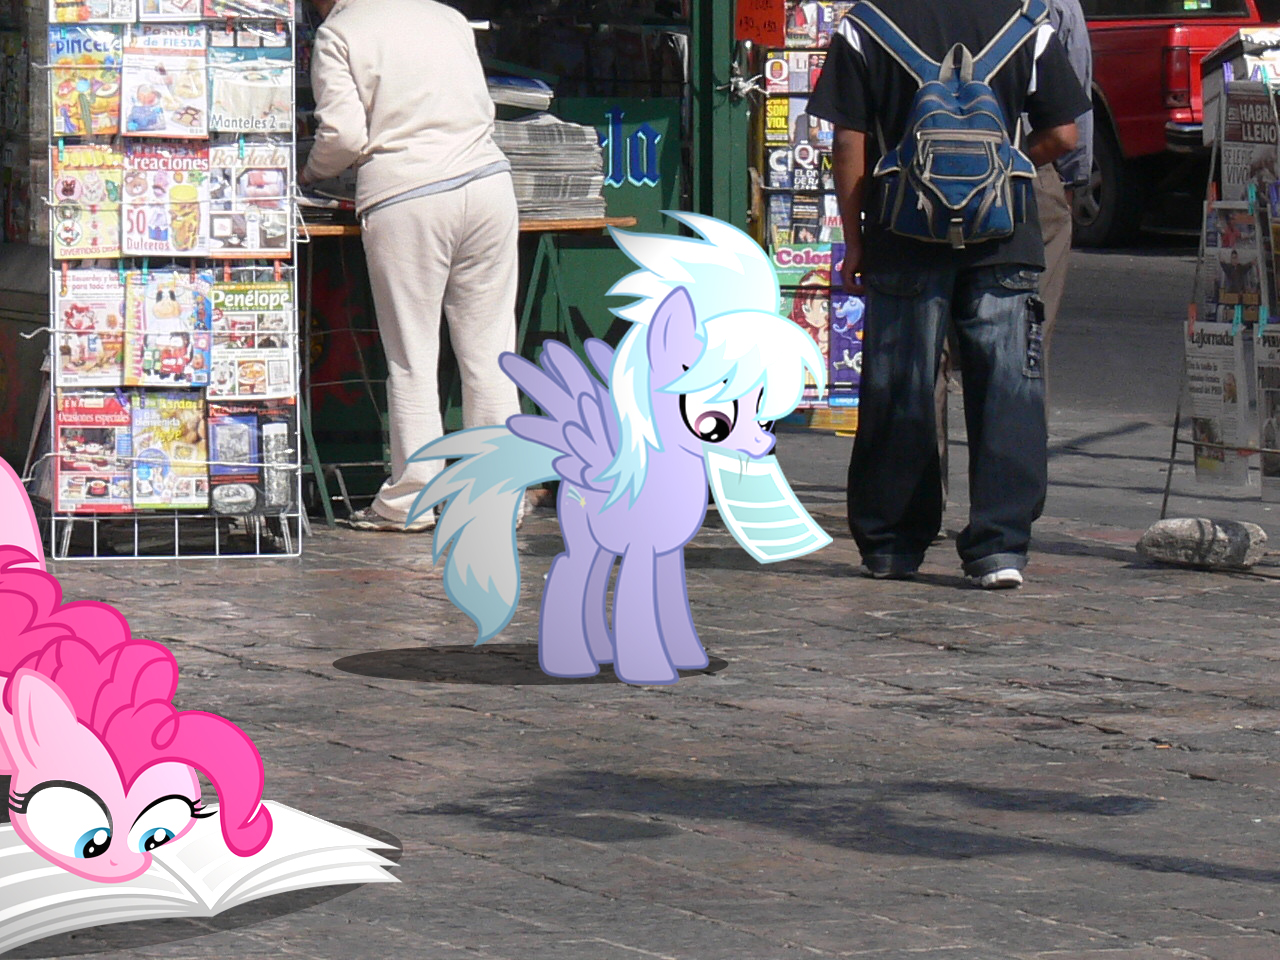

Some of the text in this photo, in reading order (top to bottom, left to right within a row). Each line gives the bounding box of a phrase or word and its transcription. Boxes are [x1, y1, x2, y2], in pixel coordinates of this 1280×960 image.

[144, 36, 202, 48] de FIESTA
[210, 114, 277, 131] Manteles 2
[124, 155, 209, 171] Creaciones
[126, 209, 147, 235] 50
[212, 289, 290, 310] Penélope
